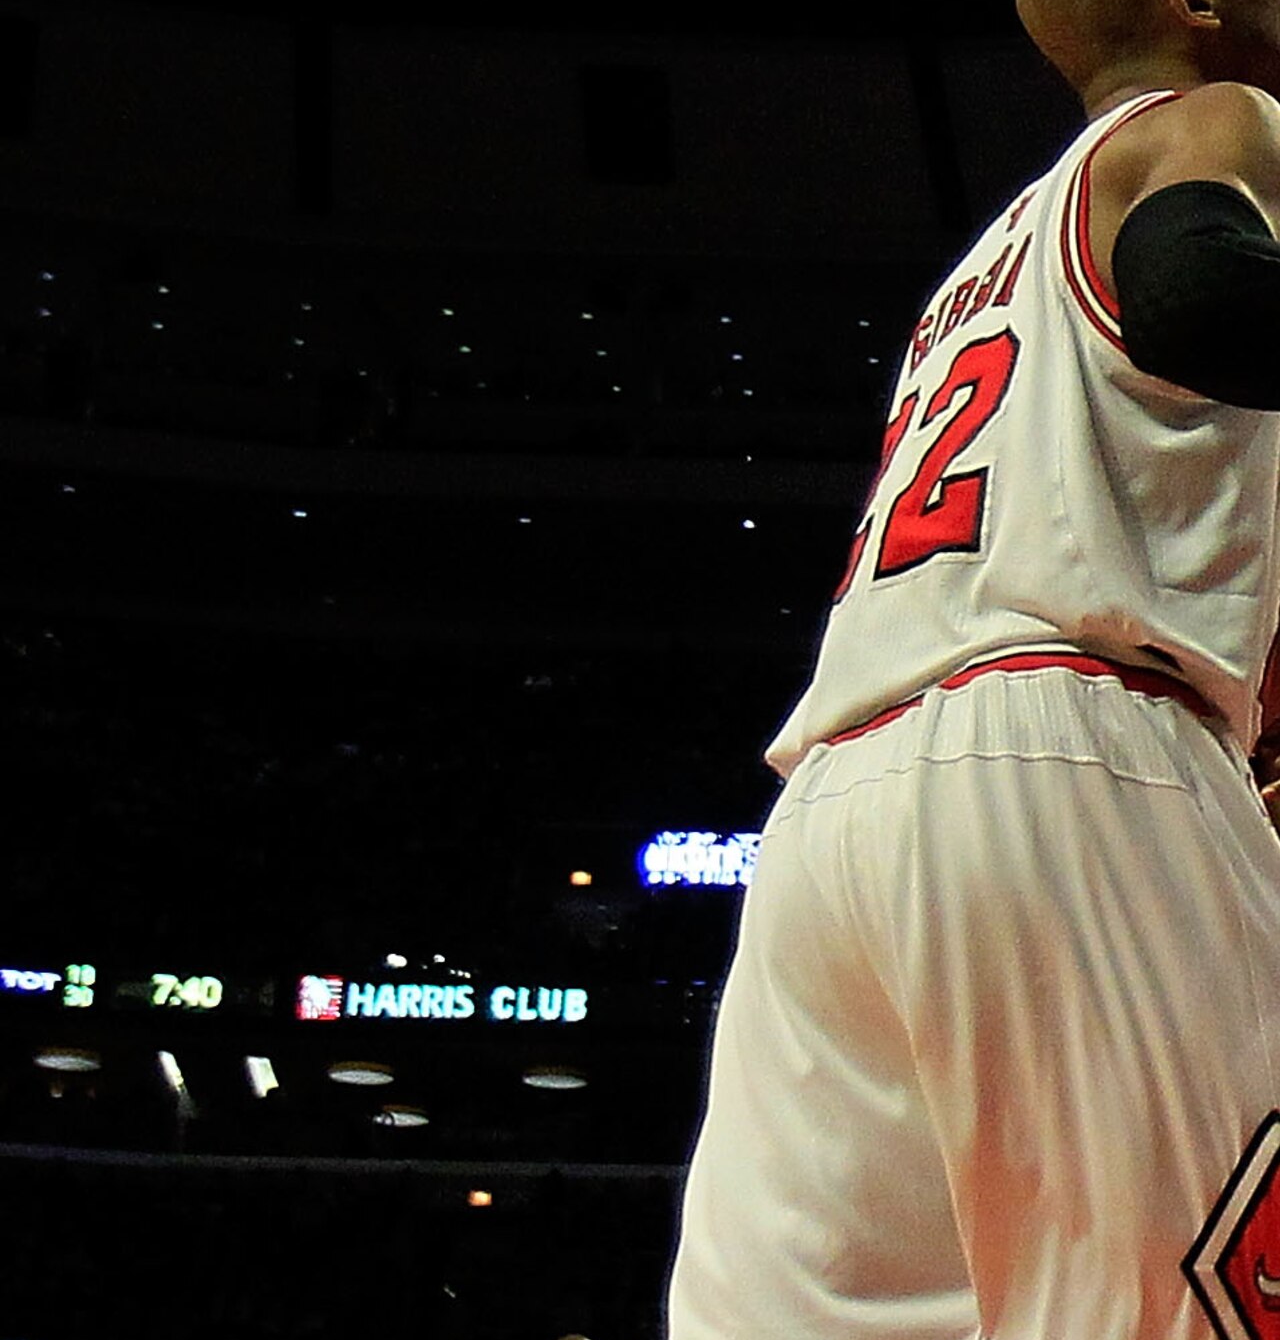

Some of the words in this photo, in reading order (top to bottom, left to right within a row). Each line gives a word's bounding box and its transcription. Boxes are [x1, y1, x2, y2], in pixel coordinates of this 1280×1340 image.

[0, 969, 62, 991] TOT
[348, 982, 475, 1019] HARRIS
[490, 985, 588, 1022] CLUB
